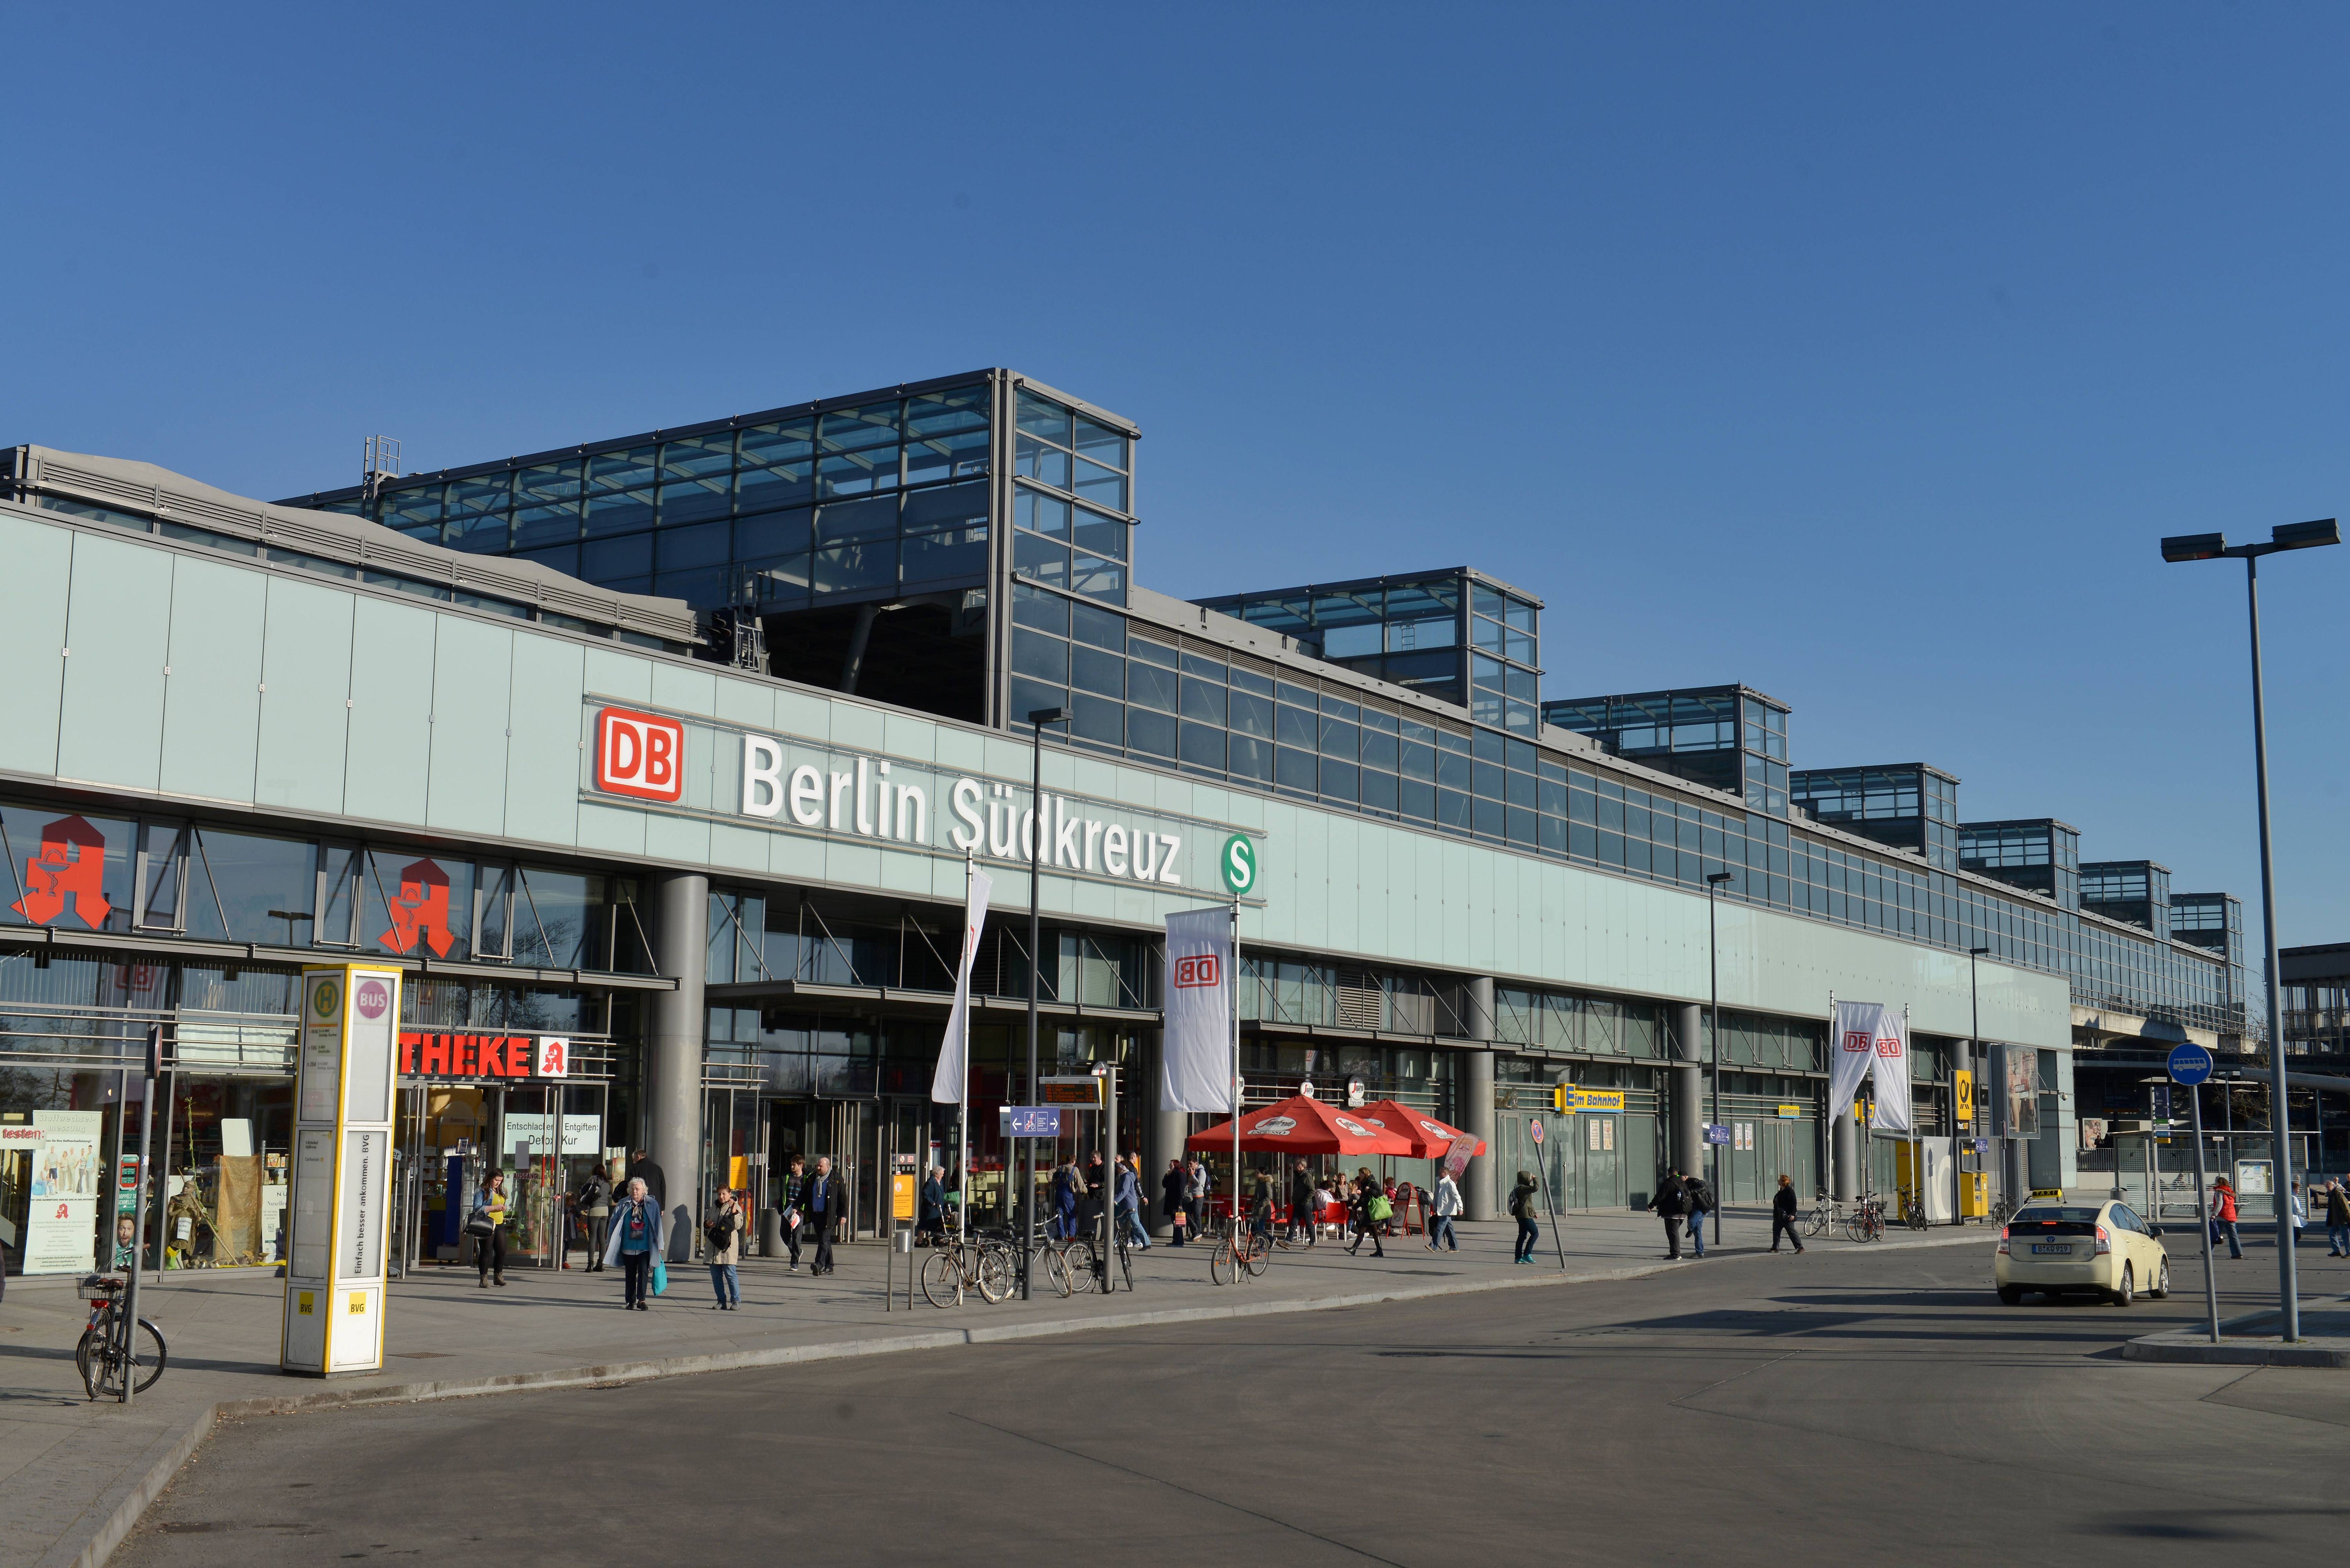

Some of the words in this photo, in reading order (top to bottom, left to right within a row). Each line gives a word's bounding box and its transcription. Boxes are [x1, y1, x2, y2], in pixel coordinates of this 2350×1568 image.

[610, 721, 672, 785] DB
[743, 734, 926, 843] Berlin
[951, 778, 1180, 884] Südkreuz
[1230, 840, 1250, 888] S
[360, 993, 385, 1008] BUS
[1847, 1035, 1867, 1049] DB
[1566, 1086, 1574, 1106] E
[1575, 1093, 1585, 1105] im
[1587, 1095, 1621, 1106] Bahnhof
[1780, 1107, 1799, 1116] Anlieferung
[2, 1128, 44, 1140] testen:
[565, 1123, 598, 1133] Entgiften:
[562, 1135, 578, 1145] Kur
[360, 1156, 368, 1206] ankommen.
[357, 1210, 365, 1238] besser
[355, 1241, 363, 1274] Einfach
[300, 1304, 312, 1313] BVG
[351, 1304, 364, 1312] BVG
